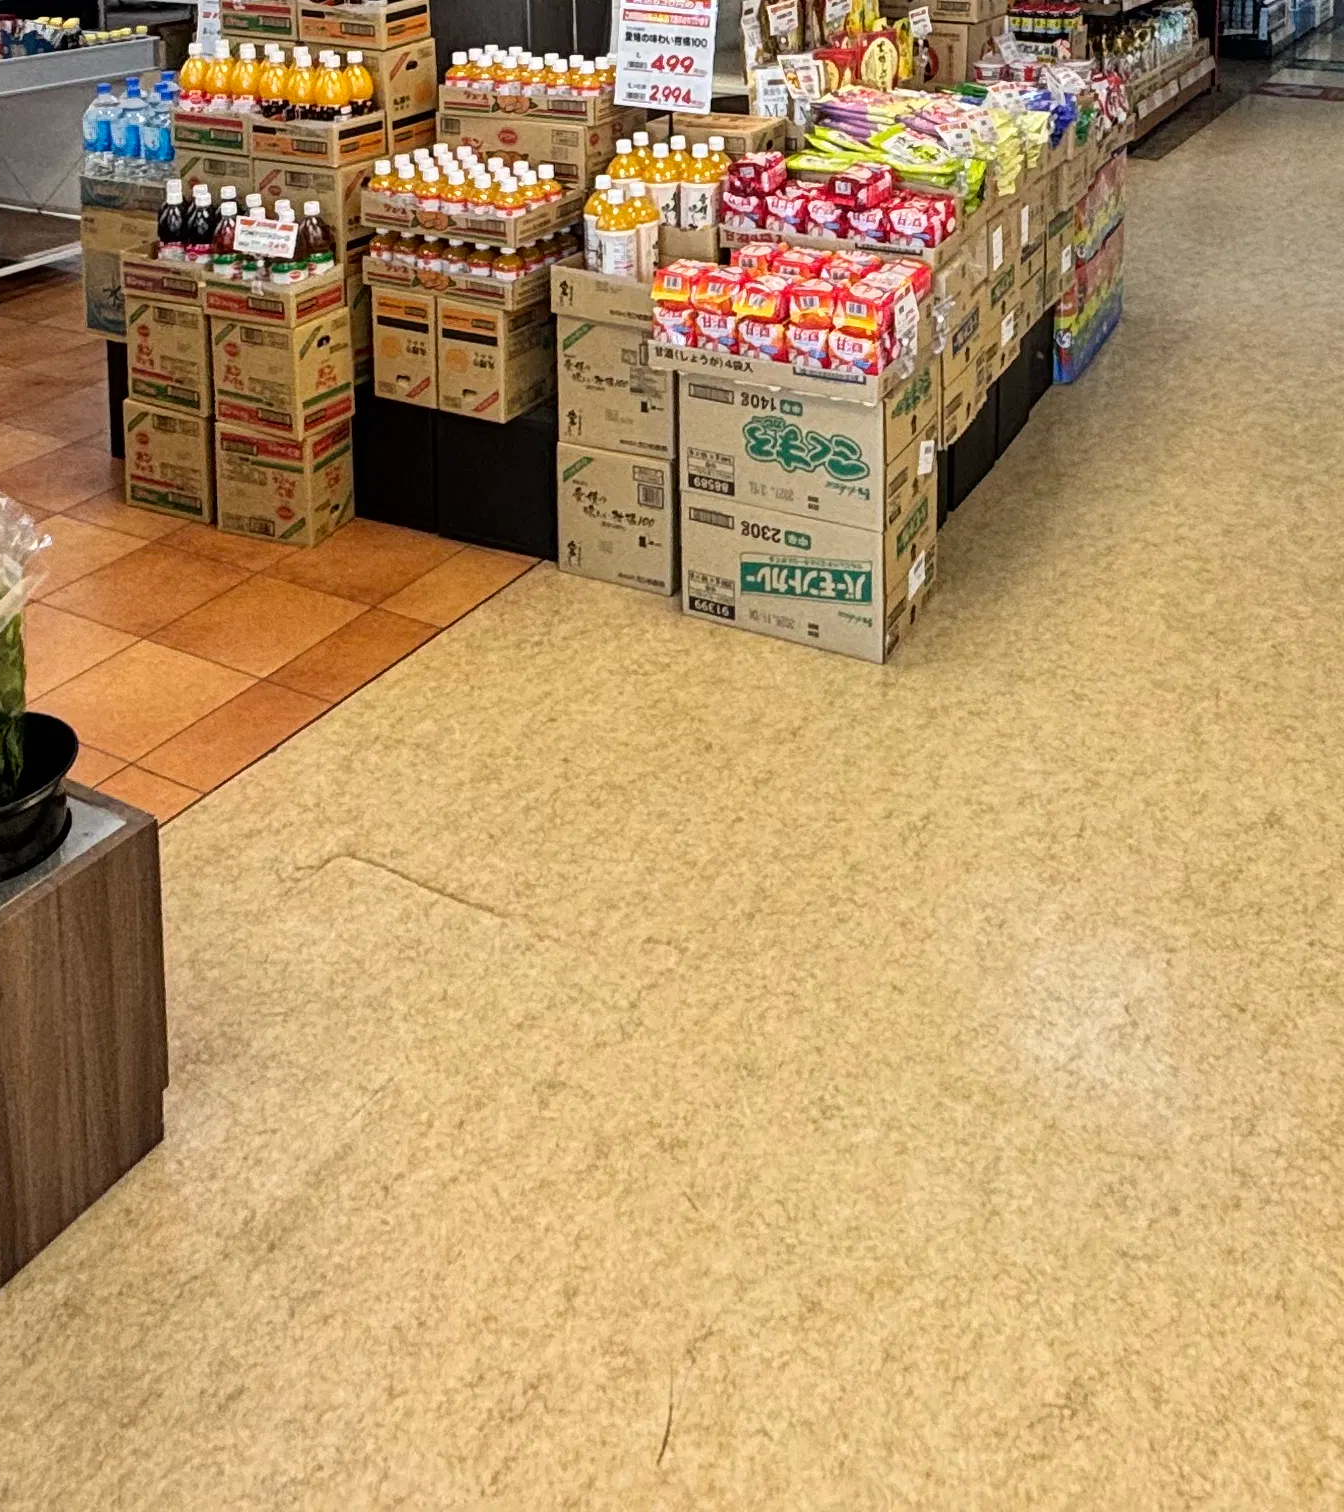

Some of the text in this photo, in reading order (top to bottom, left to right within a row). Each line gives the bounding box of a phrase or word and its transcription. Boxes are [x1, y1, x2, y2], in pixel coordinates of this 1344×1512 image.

[650, 54, 695, 74] 499
[648, 83, 693, 106] 2,994
[740, 392, 777, 411] 140g
[742, 423, 870, 482] こくまろ
[741, 520, 782, 544] 230g
[744, 566, 867, 601] バーモントカレー
